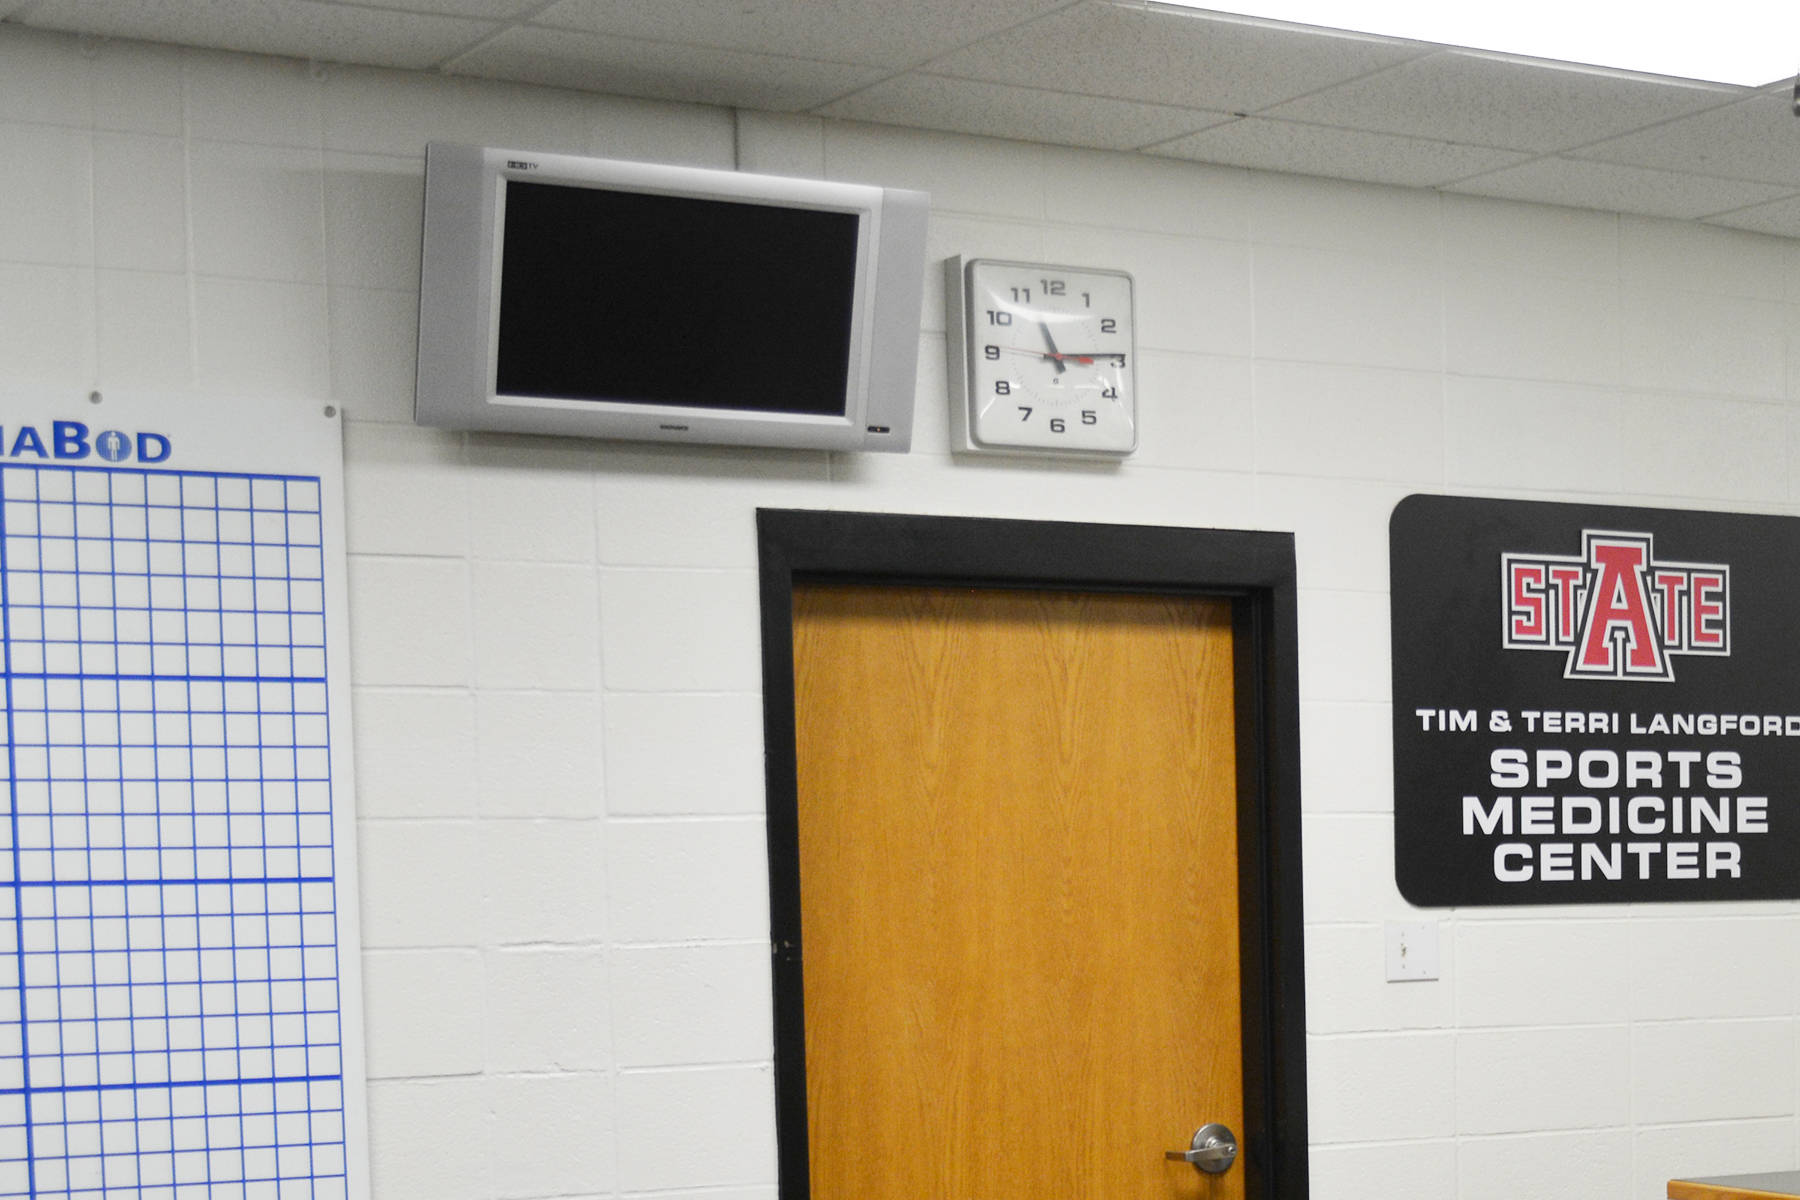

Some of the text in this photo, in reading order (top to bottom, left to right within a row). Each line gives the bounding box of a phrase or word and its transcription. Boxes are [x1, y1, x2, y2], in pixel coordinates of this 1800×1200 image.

[1011, 287, 1031, 303] 11
[1040, 279, 1066, 296] 12
[1082, 293, 1091, 308] 1
[986, 310, 1012, 326] 10
[1101, 318, 1117, 334] 2
[984, 344, 1001, 361] 9
[1110, 353, 1126, 369] 3
[995, 381, 1011, 395] 8
[1101, 386, 1118, 401] 4
[1018, 406, 1033, 422] 7
[1081, 410, 1097, 425] 5
[1050, 418, 1065, 433] 6
[0, 419, 172, 464] ABOD
[1501, 529, 1731, 683] STATE
[1415, 709, 1478, 732] TIM
[1489, 709, 1513, 733] &
[1521, 710, 1619, 734] TERRI
[1490, 748, 1743, 789] SPORTS
[1462, 796, 1769, 835] MEDICINE
[1493, 841, 1742, 882] CENTER
